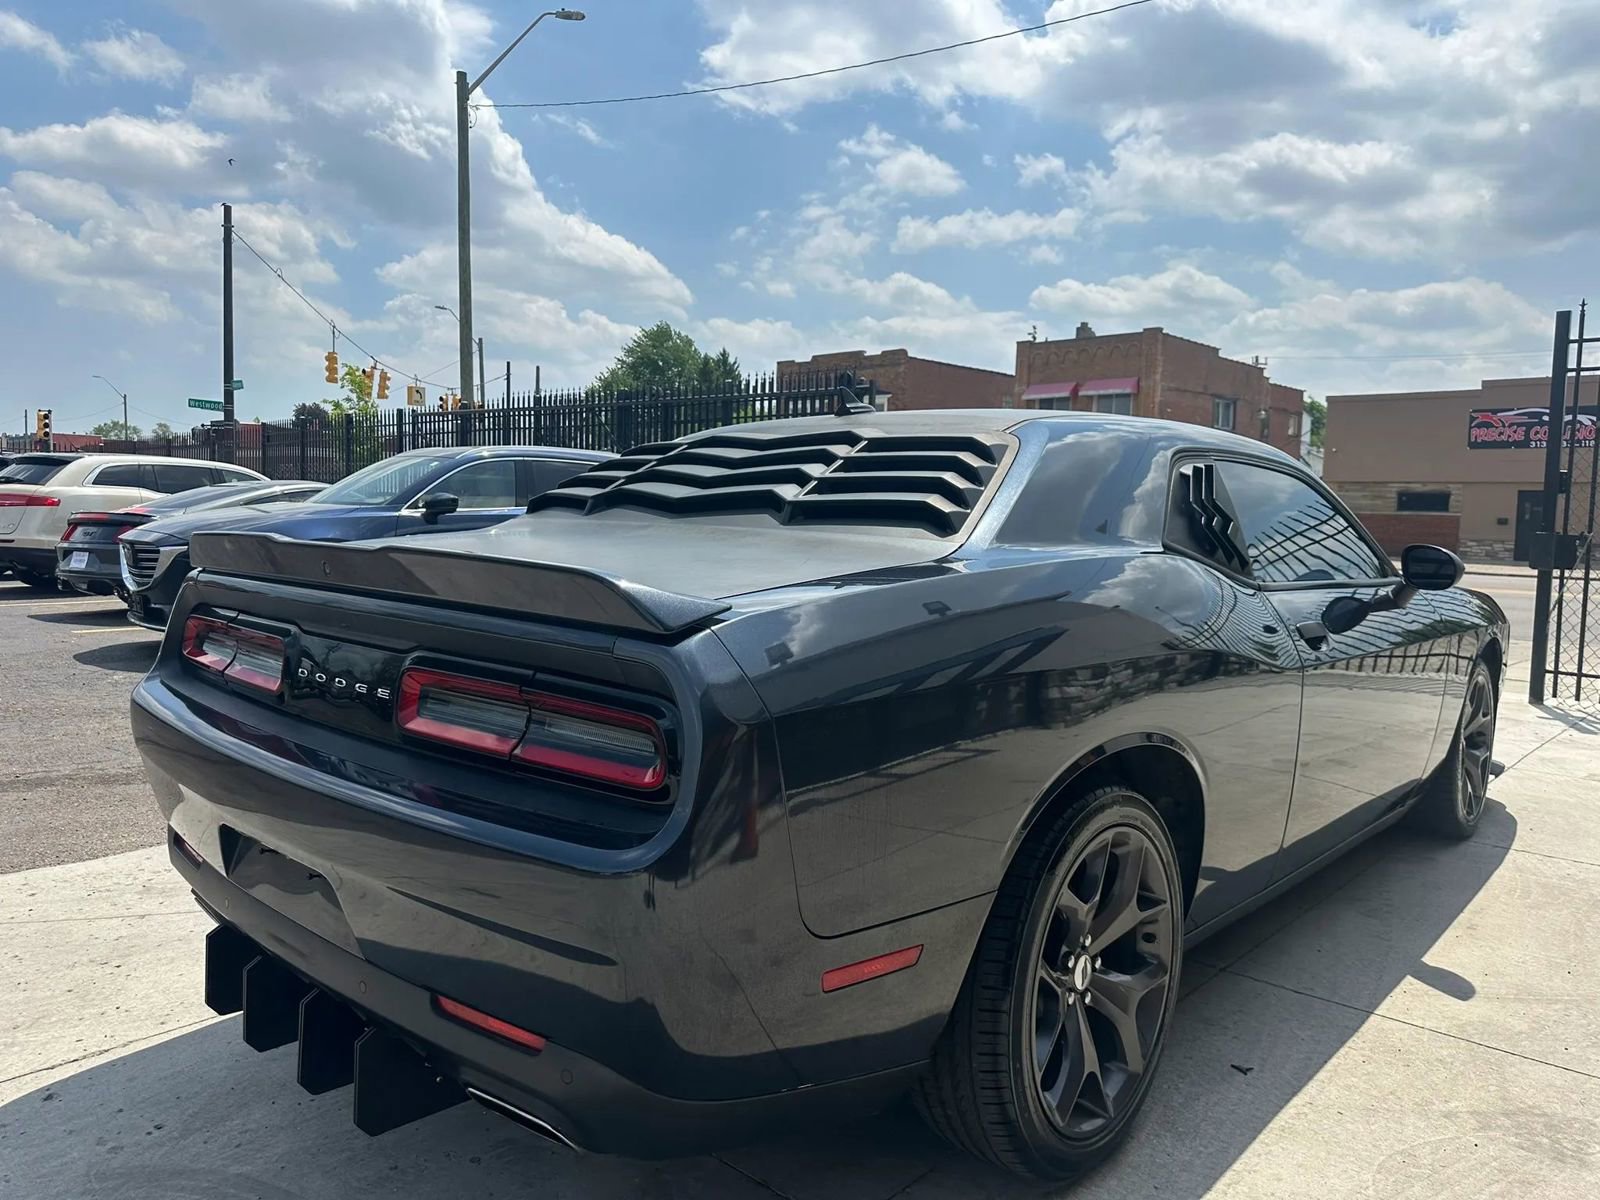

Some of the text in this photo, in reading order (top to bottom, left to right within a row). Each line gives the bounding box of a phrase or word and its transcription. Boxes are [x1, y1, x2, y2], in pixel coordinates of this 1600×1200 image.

[189, 399, 223, 410] Westwood
[1471, 425, 1526, 443] PRECISE
[298, 668, 390, 699] DODGE
